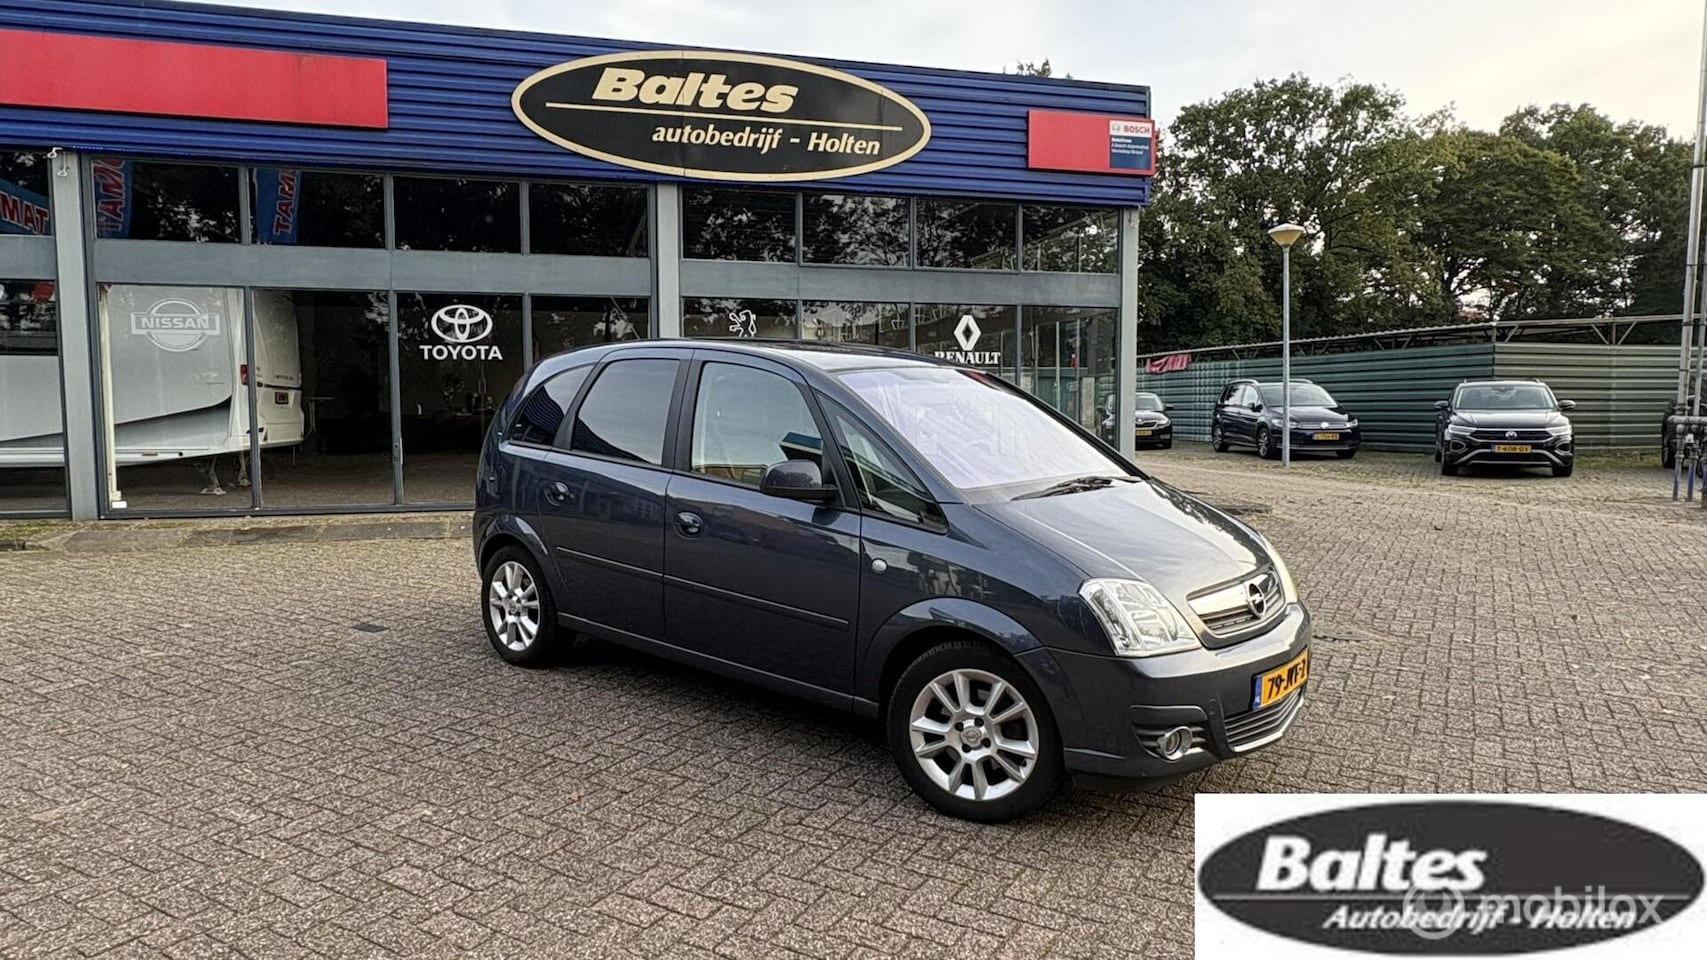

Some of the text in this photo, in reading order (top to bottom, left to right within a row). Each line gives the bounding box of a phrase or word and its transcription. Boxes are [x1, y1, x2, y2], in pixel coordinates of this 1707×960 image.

[591, 66, 799, 114] Baltes
[1123, 125, 1150, 134] BOSCH
[651, 124, 781, 154] autobedrijf
[807, 131, 880, 155] Holten
[141, 317, 210, 329] NISSAN
[419, 345, 503, 360] TOYOTA
